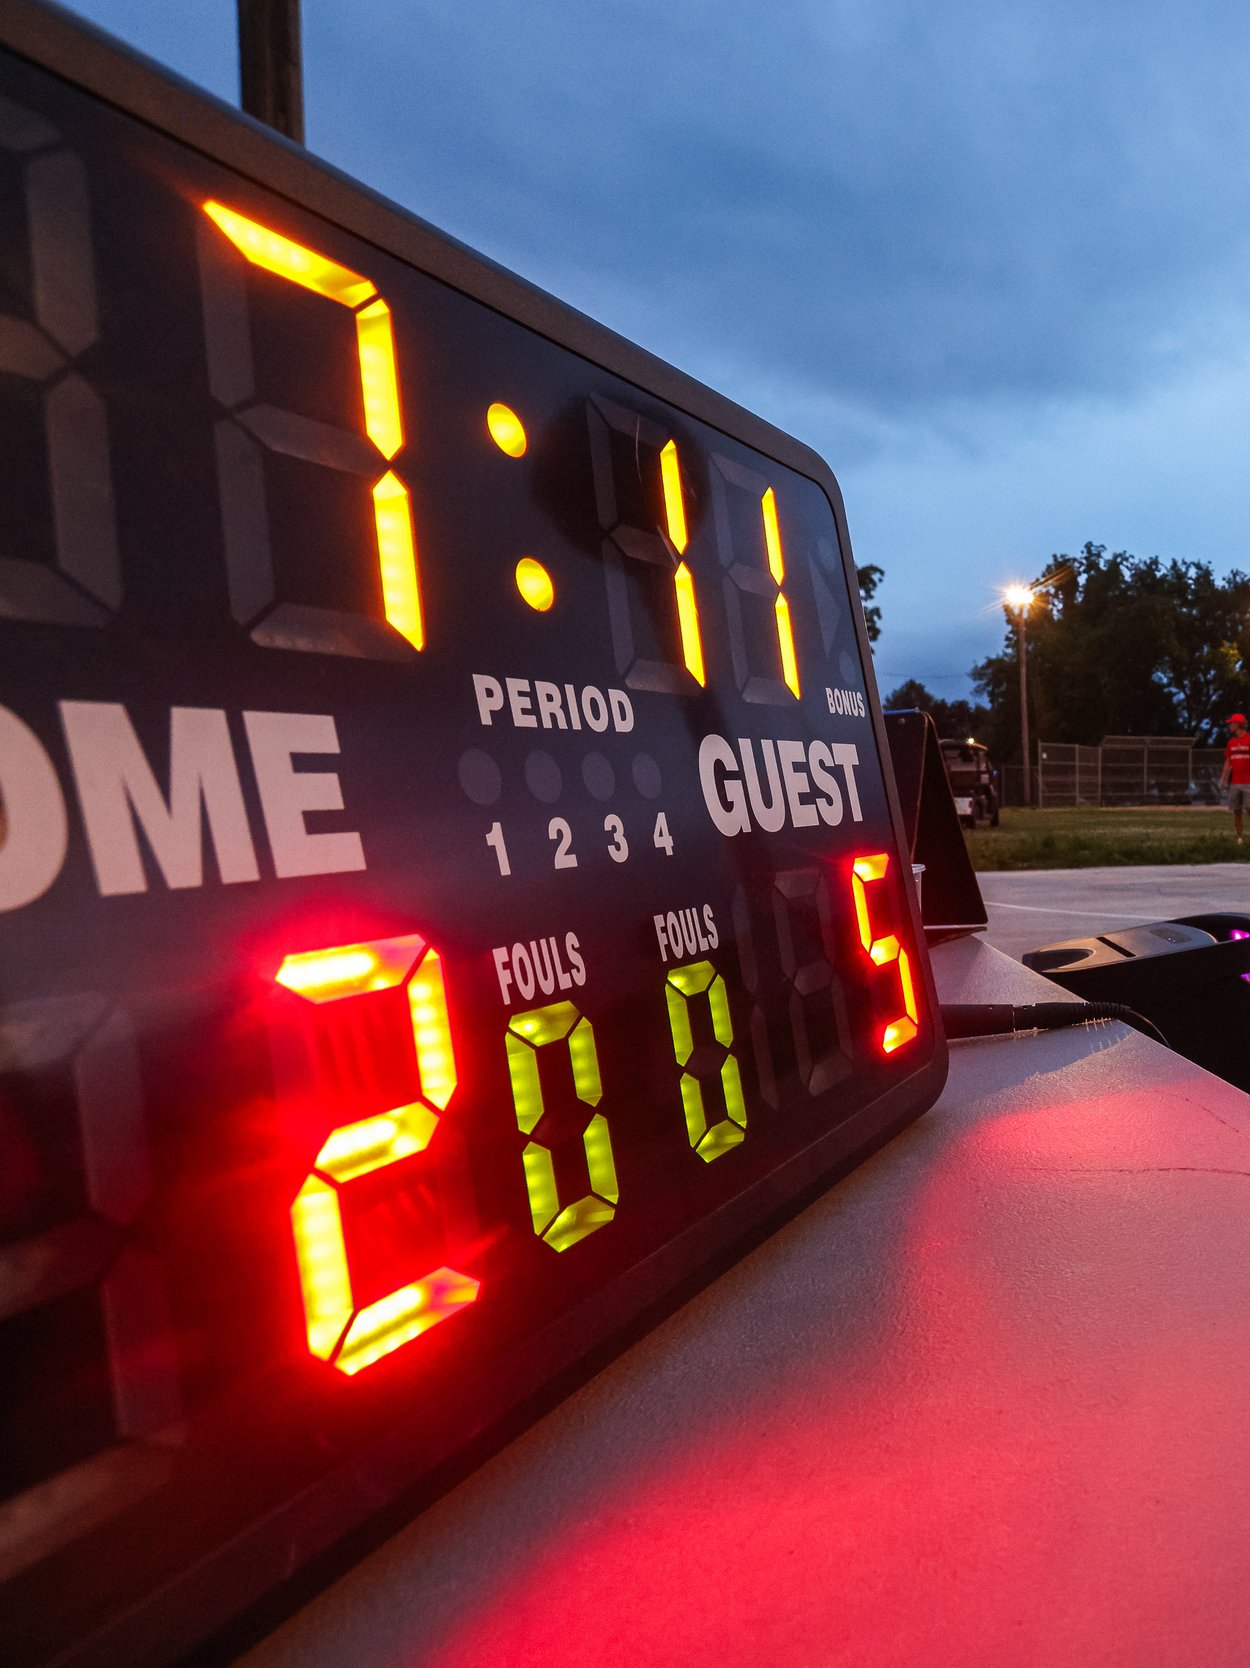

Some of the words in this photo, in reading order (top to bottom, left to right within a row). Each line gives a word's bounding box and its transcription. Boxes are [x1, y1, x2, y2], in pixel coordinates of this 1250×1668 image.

[472, 673, 635, 732] PERIOD
[825, 687, 866, 718] BONUS
[698, 733, 864, 837] GUEST
[485, 821, 511, 876] 1
[547, 817, 578, 869] 2
[603, 814, 629, 863] 3
[653, 812, 674, 856] 4
[492, 931, 587, 1005] FOULS
[653, 903, 719, 962] FOULS
[851, 852, 918, 1054] 5
[664, 960, 748, 1163] 0
[275, 933, 481, 1377] 2
[504, 1000, 620, 1253] 0
